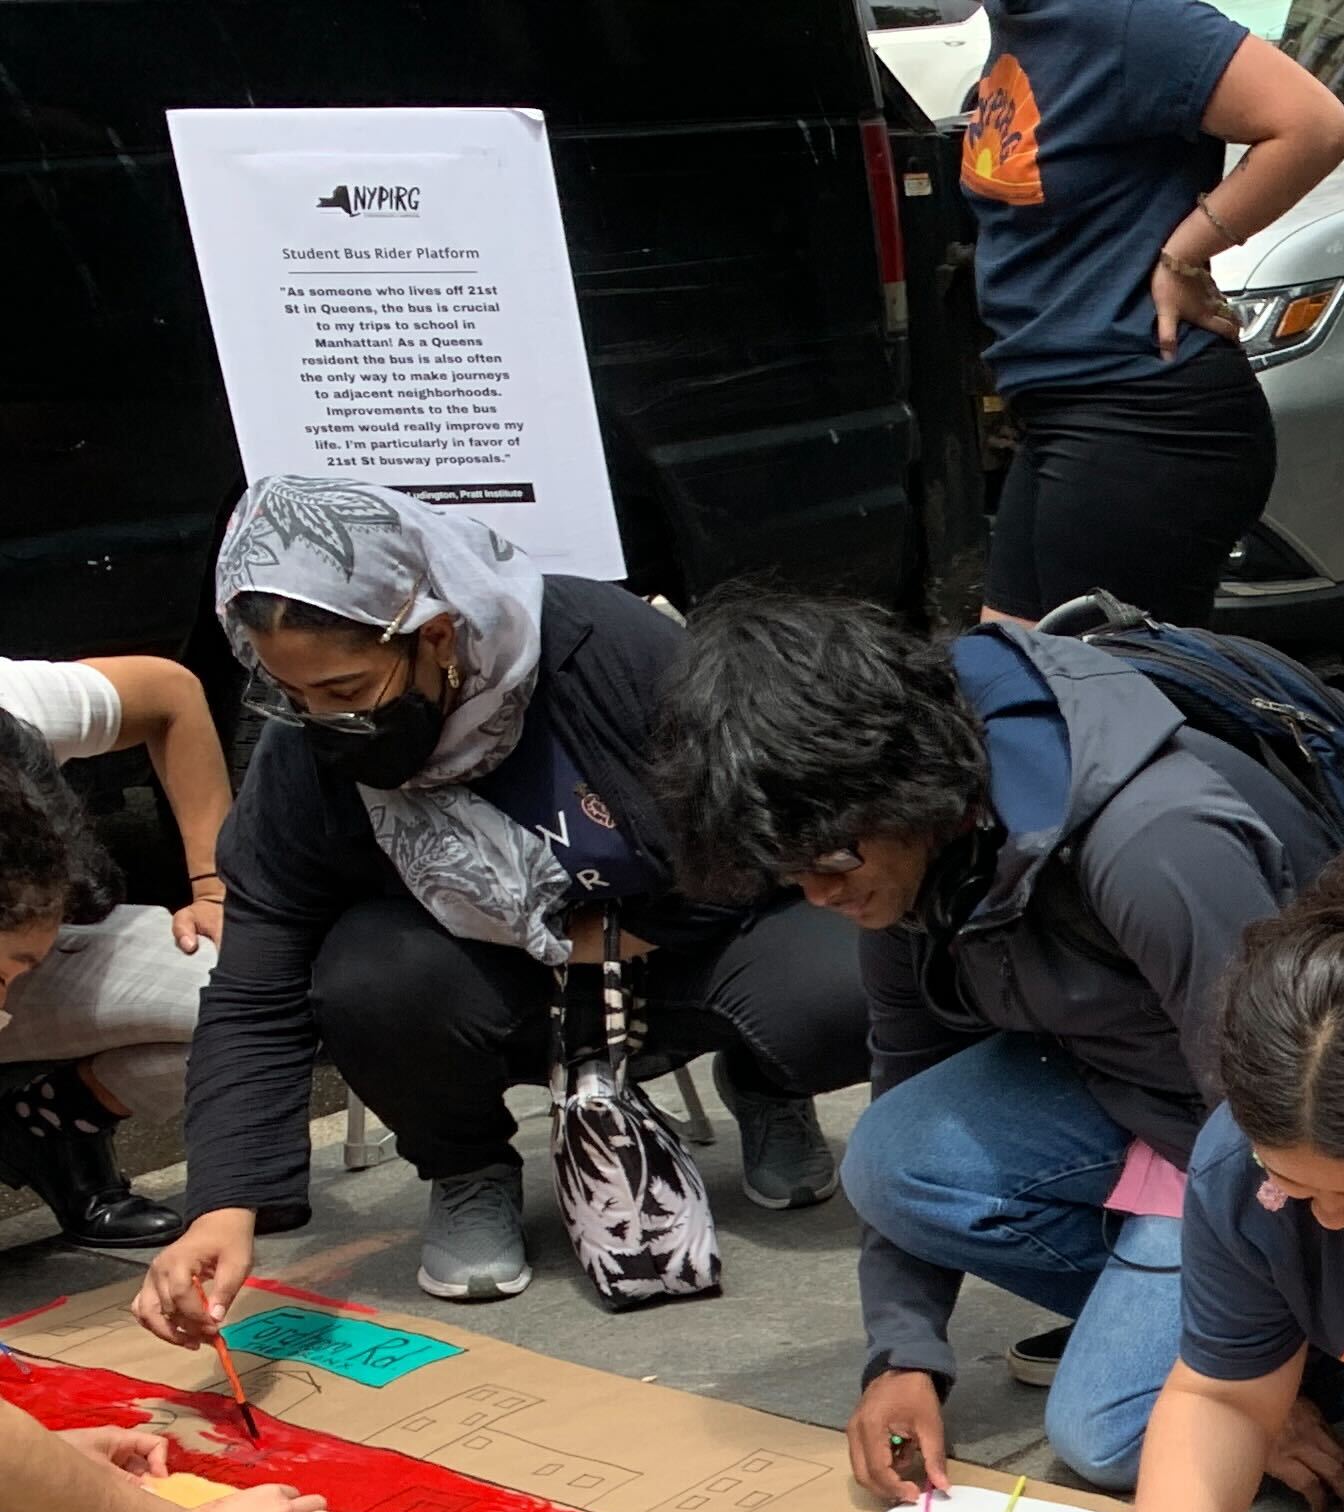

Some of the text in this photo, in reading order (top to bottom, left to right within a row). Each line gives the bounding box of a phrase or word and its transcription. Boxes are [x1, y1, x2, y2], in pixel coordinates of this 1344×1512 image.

[353, 184, 422, 211] NYPIRG
[282, 246, 480, 260] Student Bus Rider Platform
[279, 284, 499, 297] "As someone who lives off 21st
[283, 301, 501, 316] St in Queens, the bus is crucial
[315, 319, 477, 334] to my trips to school in
[314, 335, 484, 349] Manhattan! As a Queens
[301, 352, 503, 366] resident the bus is also often
[299, 370, 511, 385] the only way to make journeys
[313, 386, 503, 402] to adjacent neighborhoods.
[325, 403, 498, 419] Improvements to the bus
[304, 420, 525, 436] system would really improve my
[314, 436, 521, 452] life. I'm particularly in favor of
[326, 453, 512, 468] 21st St busway proposals."
